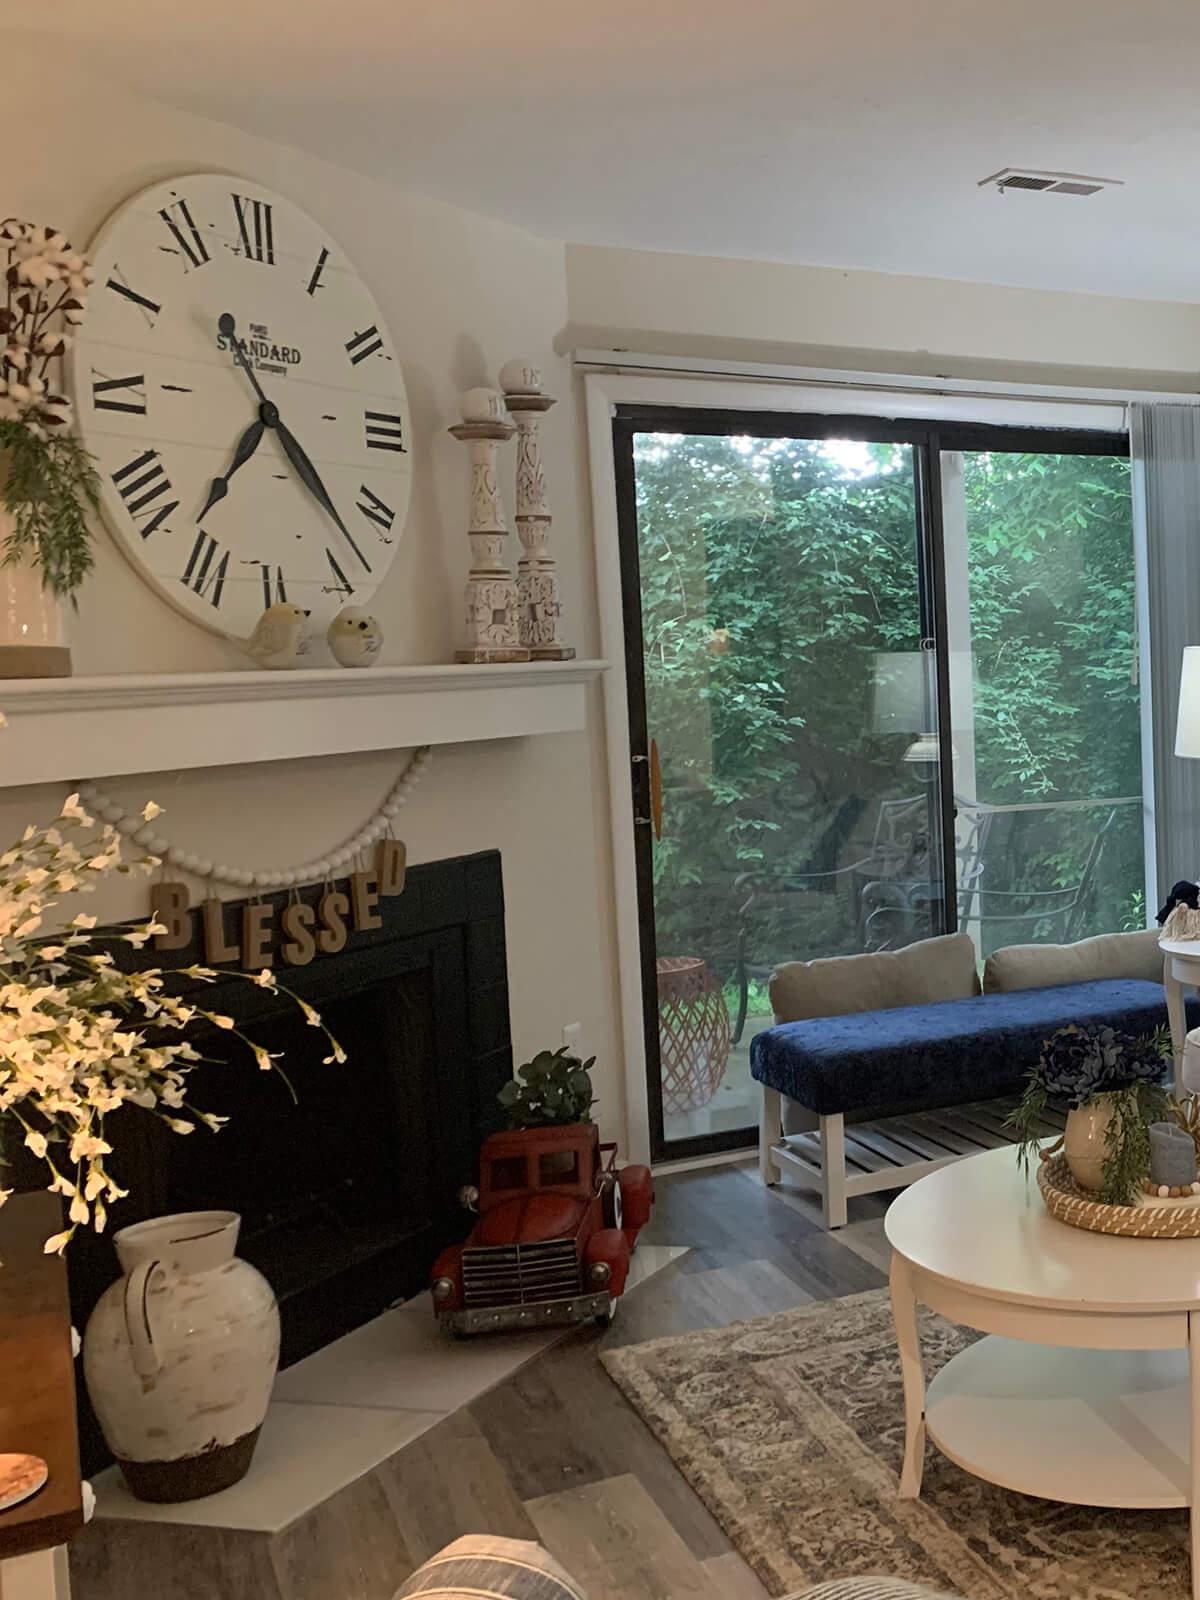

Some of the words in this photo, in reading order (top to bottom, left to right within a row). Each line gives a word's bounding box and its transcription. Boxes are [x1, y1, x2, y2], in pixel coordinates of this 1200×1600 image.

[158, 199, 211, 274] XI
[231, 193, 276, 266] XII
[106, 264, 162, 328] X
[307, 246, 330, 297] I
[345, 325, 384, 365] II
[91, 368, 147, 415] IX
[364, 411, 403, 451] III
[111, 449, 180, 541] VIII
[355, 482, 396, 543] IV
[181, 528, 231, 610] VII
[150, 839, 407, 970] BLESSED
